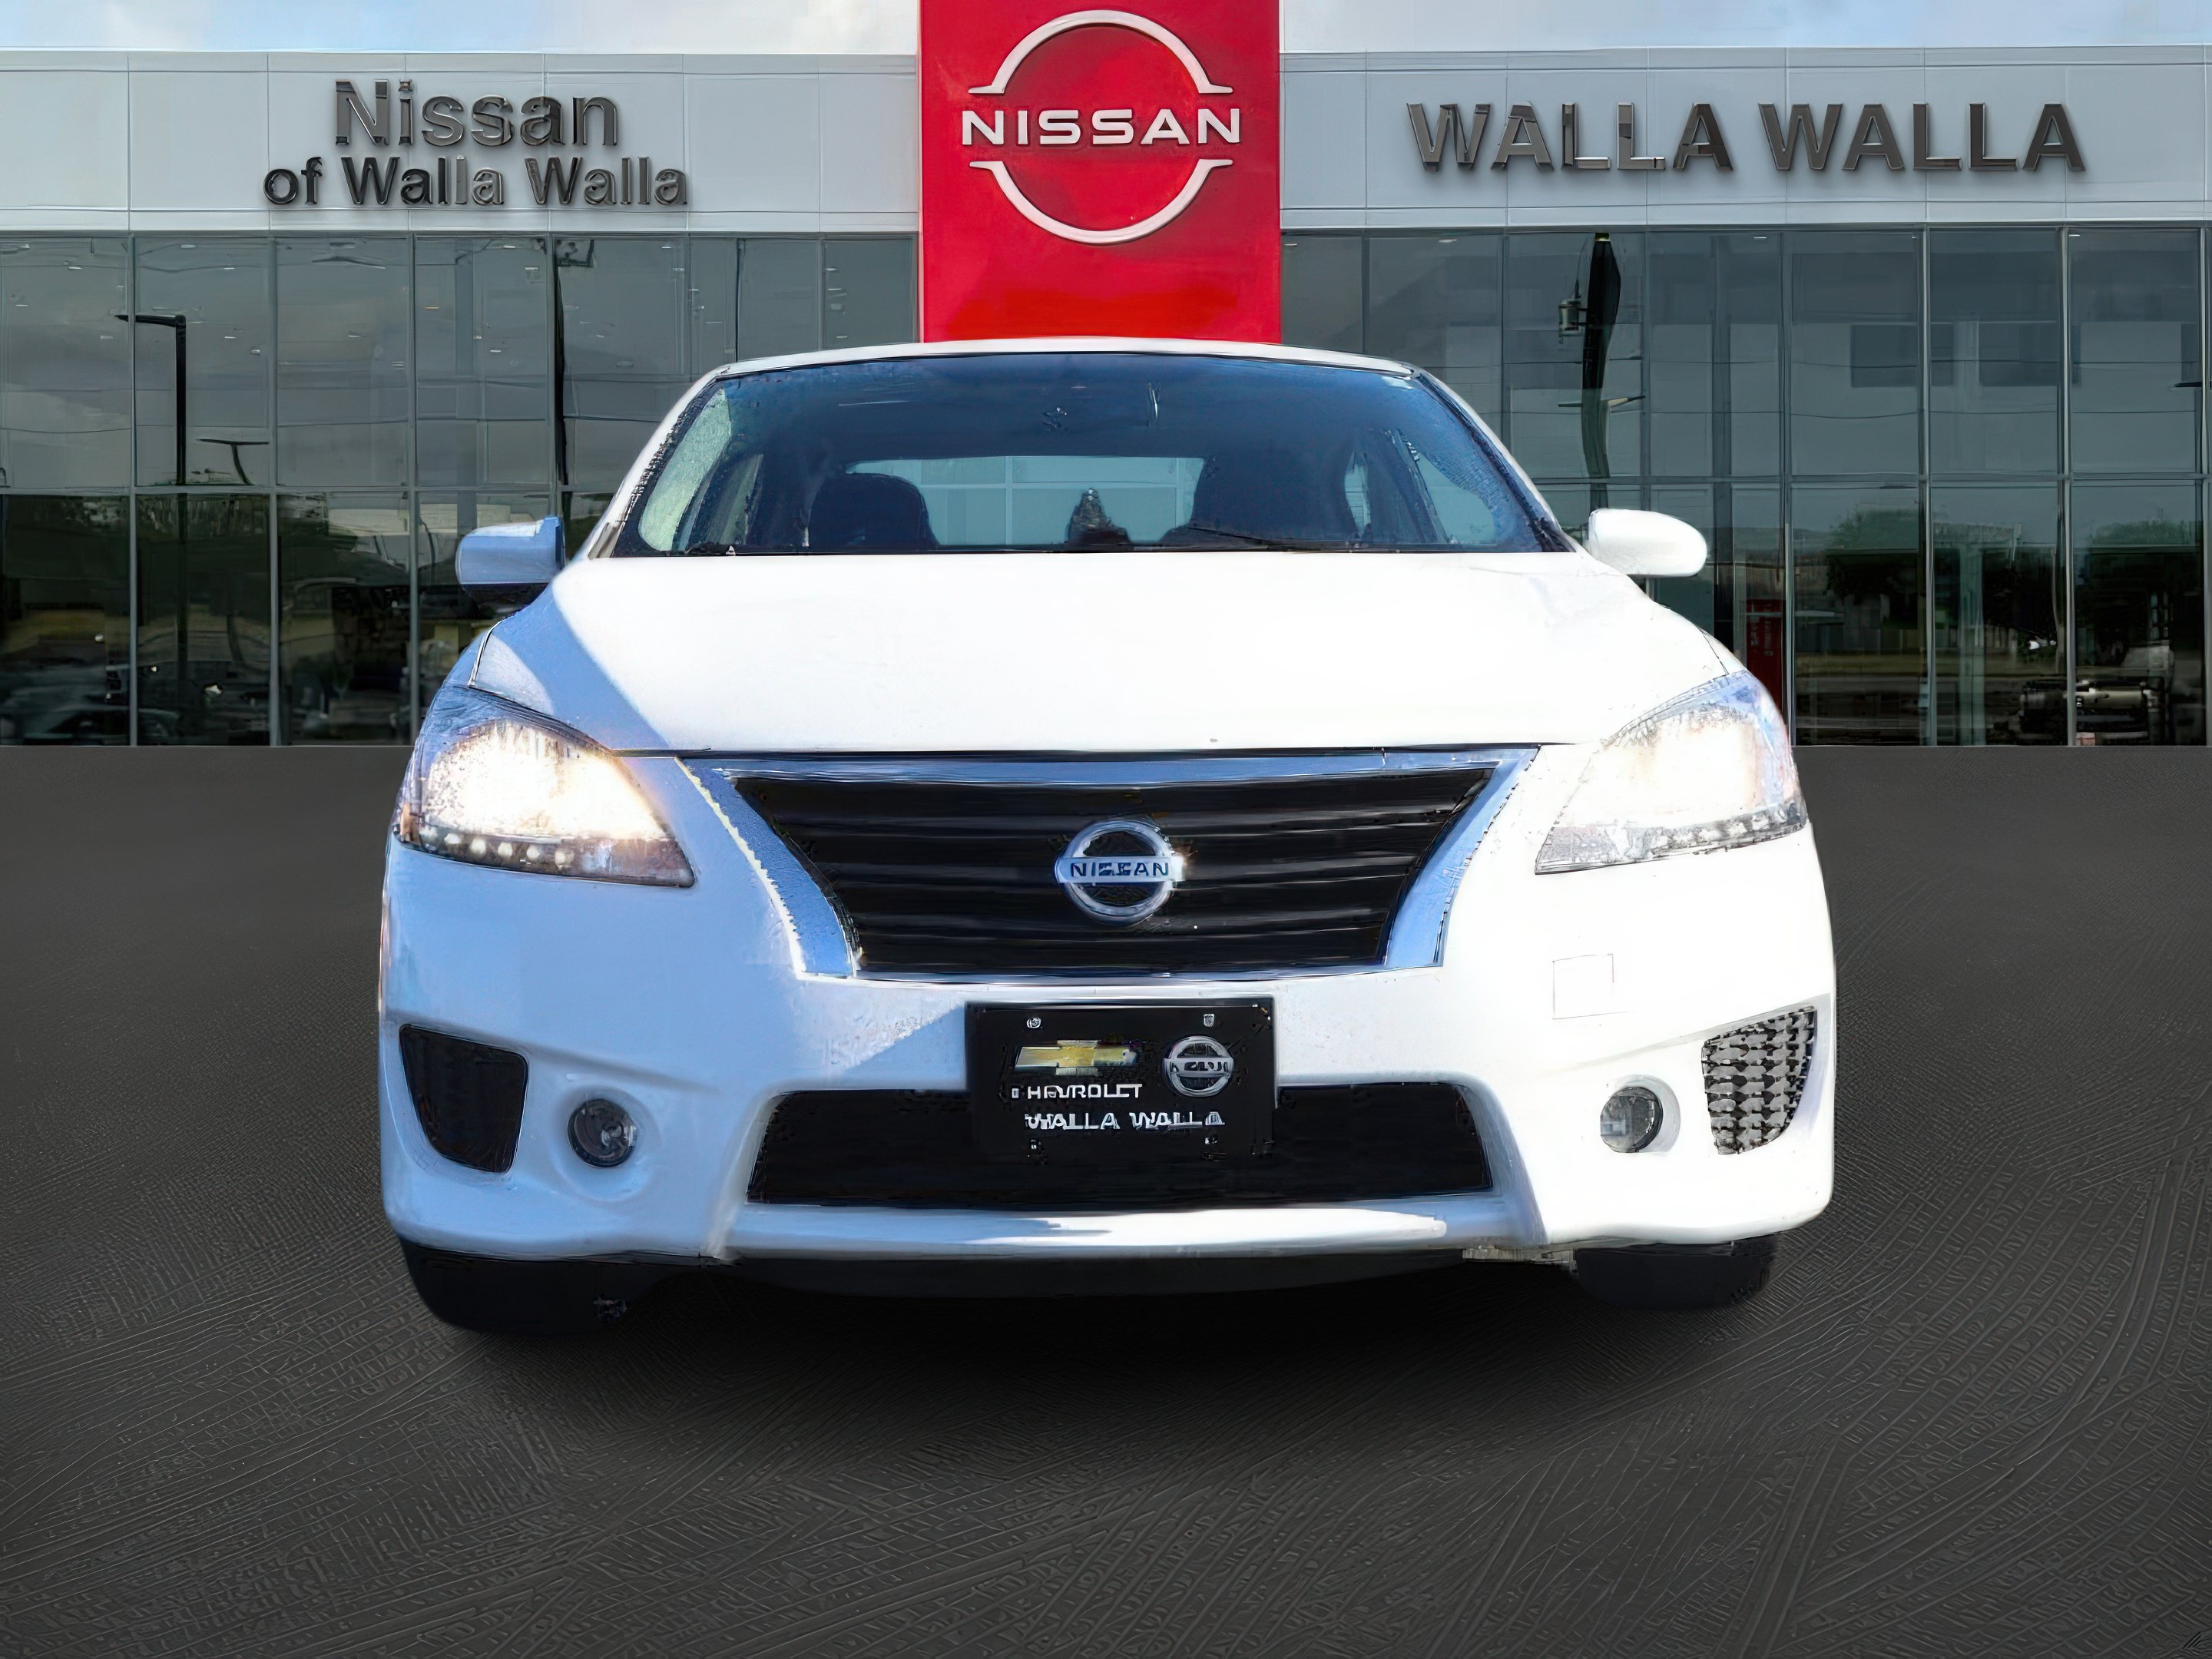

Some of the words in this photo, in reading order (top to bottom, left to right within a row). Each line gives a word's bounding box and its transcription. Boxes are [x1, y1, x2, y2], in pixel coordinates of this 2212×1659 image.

[335, 78, 618, 146] Nissan
[962, 108, 1240, 145] NISSAN
[1406, 101, 1734, 171] WALLA
[1757, 102, 2087, 172] WALLA
[263, 156, 323, 205] of
[340, 156, 505, 206] Walla
[524, 156, 688, 206] Walla
[1070, 862, 1169, 877] NISSAN
